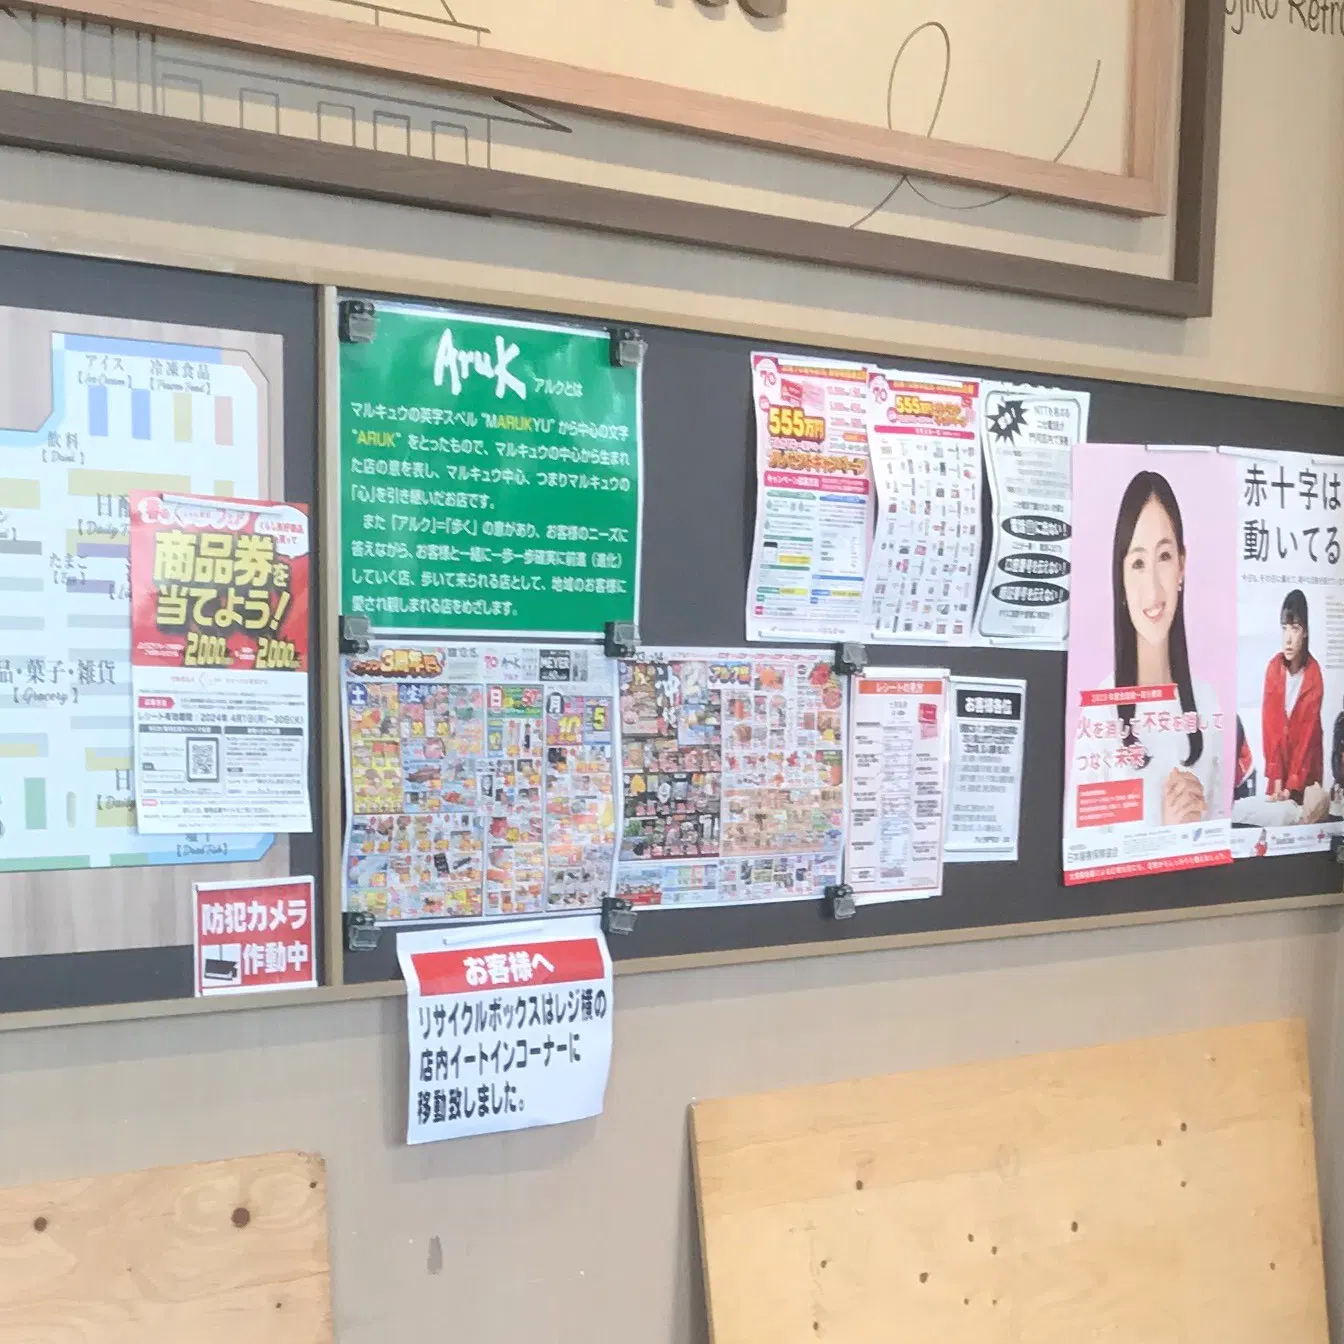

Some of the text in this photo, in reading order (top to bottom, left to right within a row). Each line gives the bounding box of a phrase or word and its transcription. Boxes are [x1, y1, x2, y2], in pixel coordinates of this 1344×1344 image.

[152, 528, 290, 589] 商品券を
[200, 899, 309, 936] 防犯カメラ
[241, 942, 310, 977] 作動中
[462, 950, 556, 986] お客様へ
[417, 987, 608, 1040] リサイクルボックスはレジ横の
[419, 1031, 582, 1082] 店内イートインコーナーに
[416, 1080, 526, 1125] 移動致しました。
